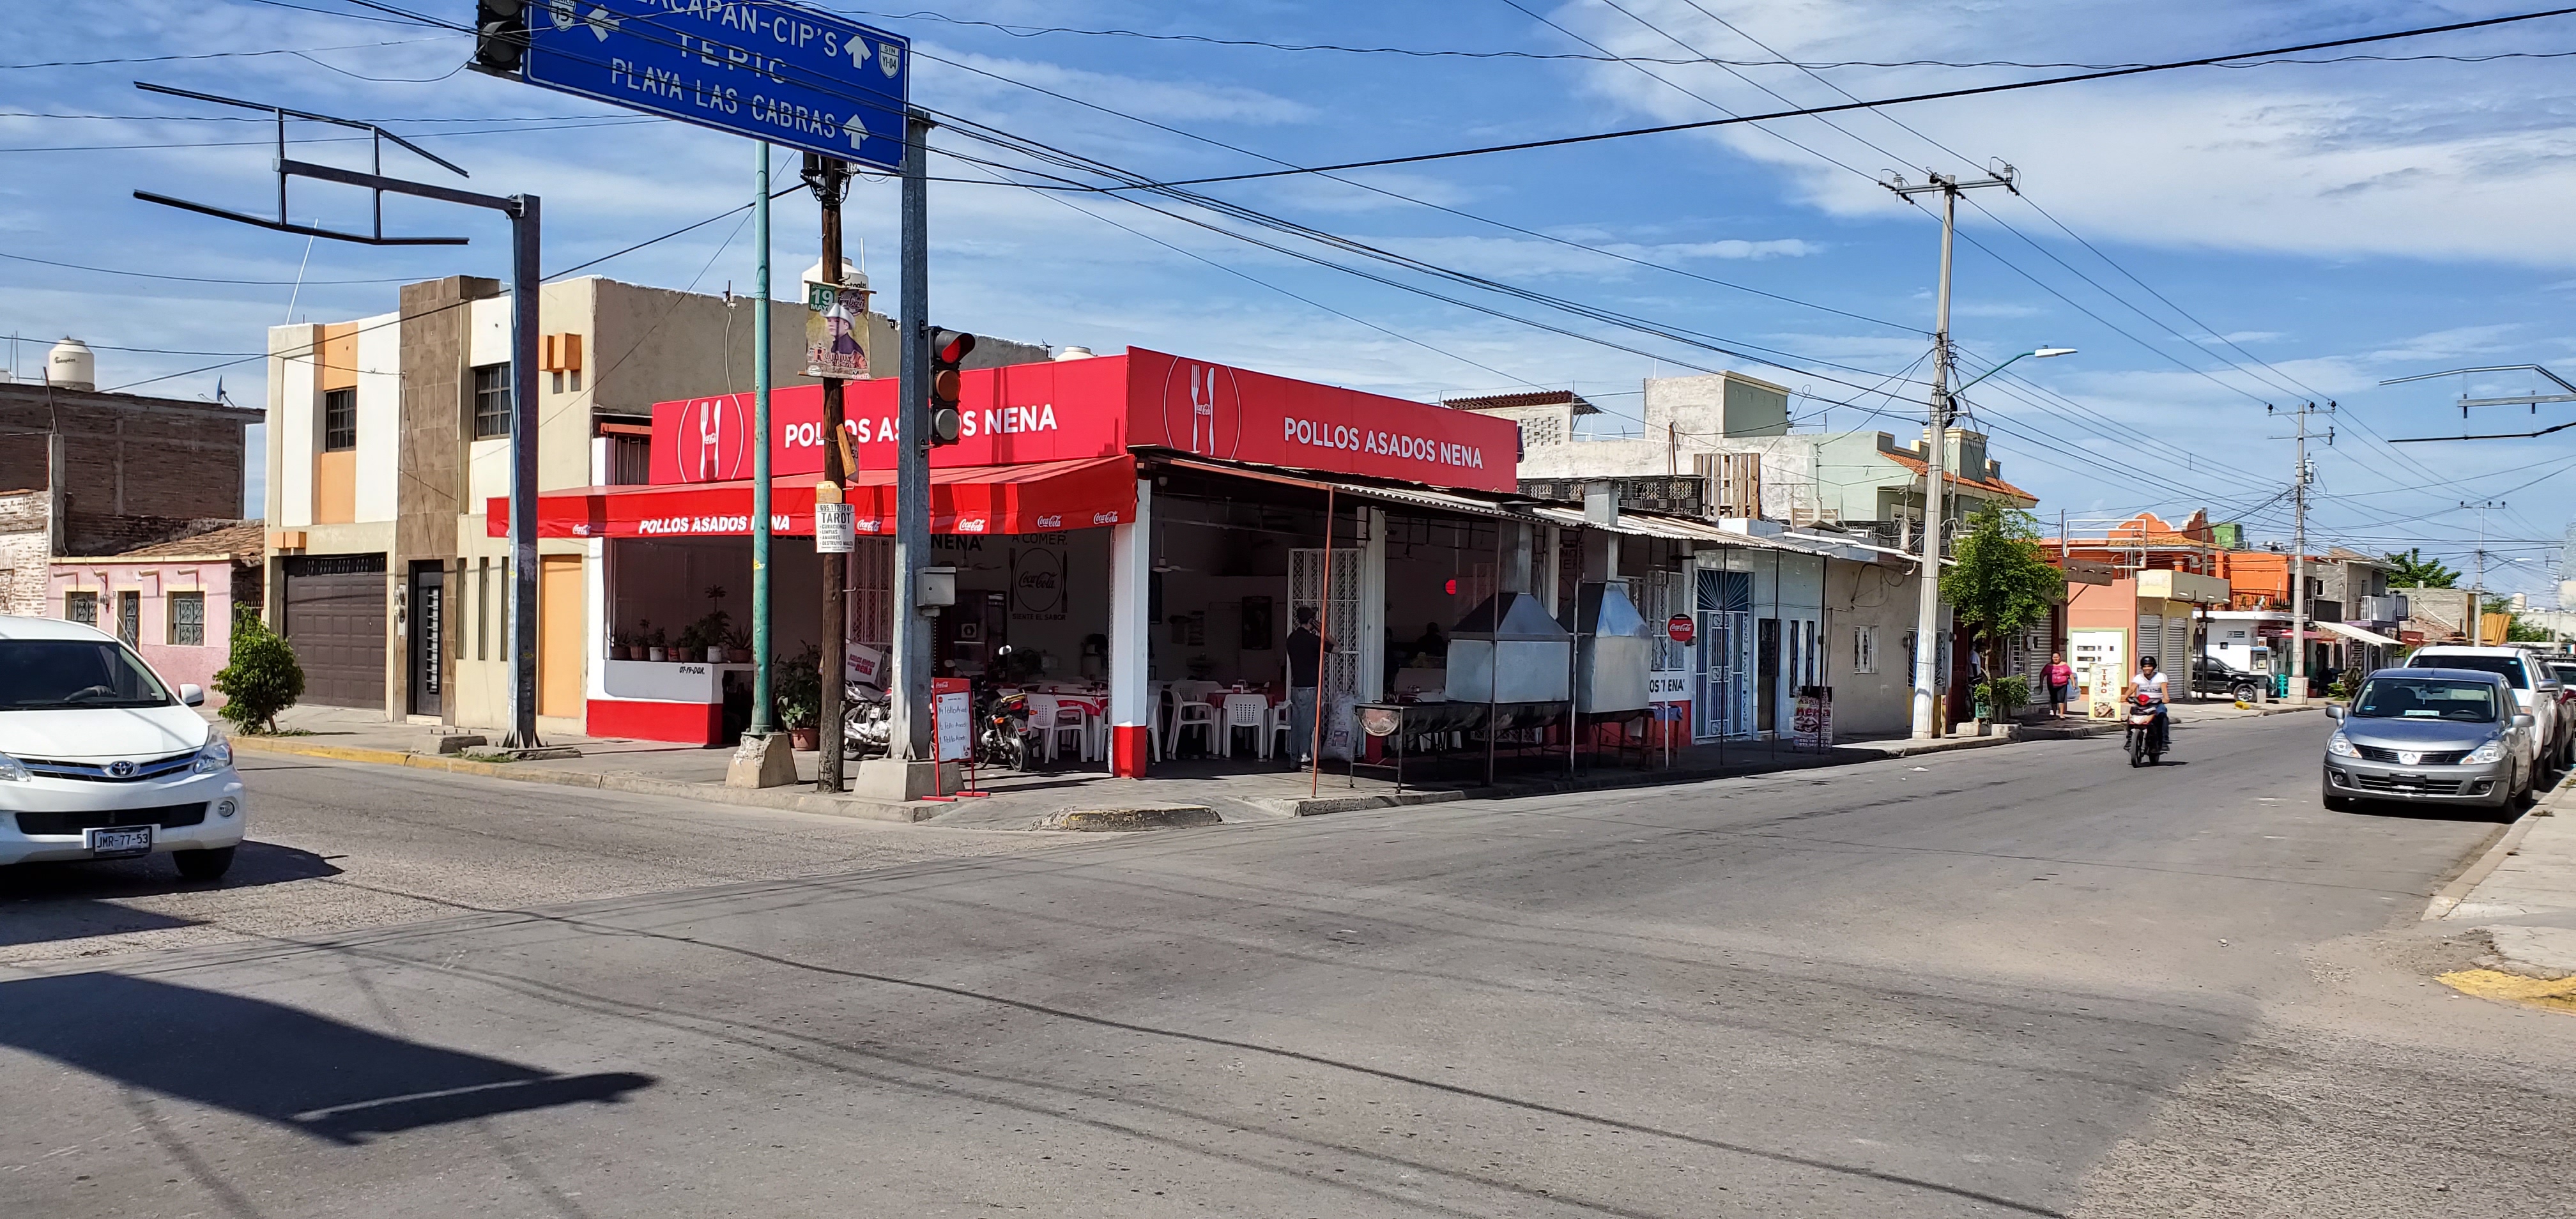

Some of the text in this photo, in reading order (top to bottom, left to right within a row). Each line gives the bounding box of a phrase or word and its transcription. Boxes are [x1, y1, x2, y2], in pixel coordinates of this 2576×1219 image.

[676, 32, 786, 84] TEPIC
[884, 45, 896, 54] SIN
[612, 57, 836, 139] PLAYA LAS CABRAS
[811, 289, 834, 305] 19
[785, 417, 871, 448] POLOS
[985, 404, 1058, 435] NENA
[1284, 417, 1483, 470] POLLOS ASADOS NENA
[639, 517, 689, 534] POLLOS
[691, 516, 747, 532] ASADOS
[821, 512, 851, 524] TAROT
[97, 833, 148, 848] JMR-77-53
